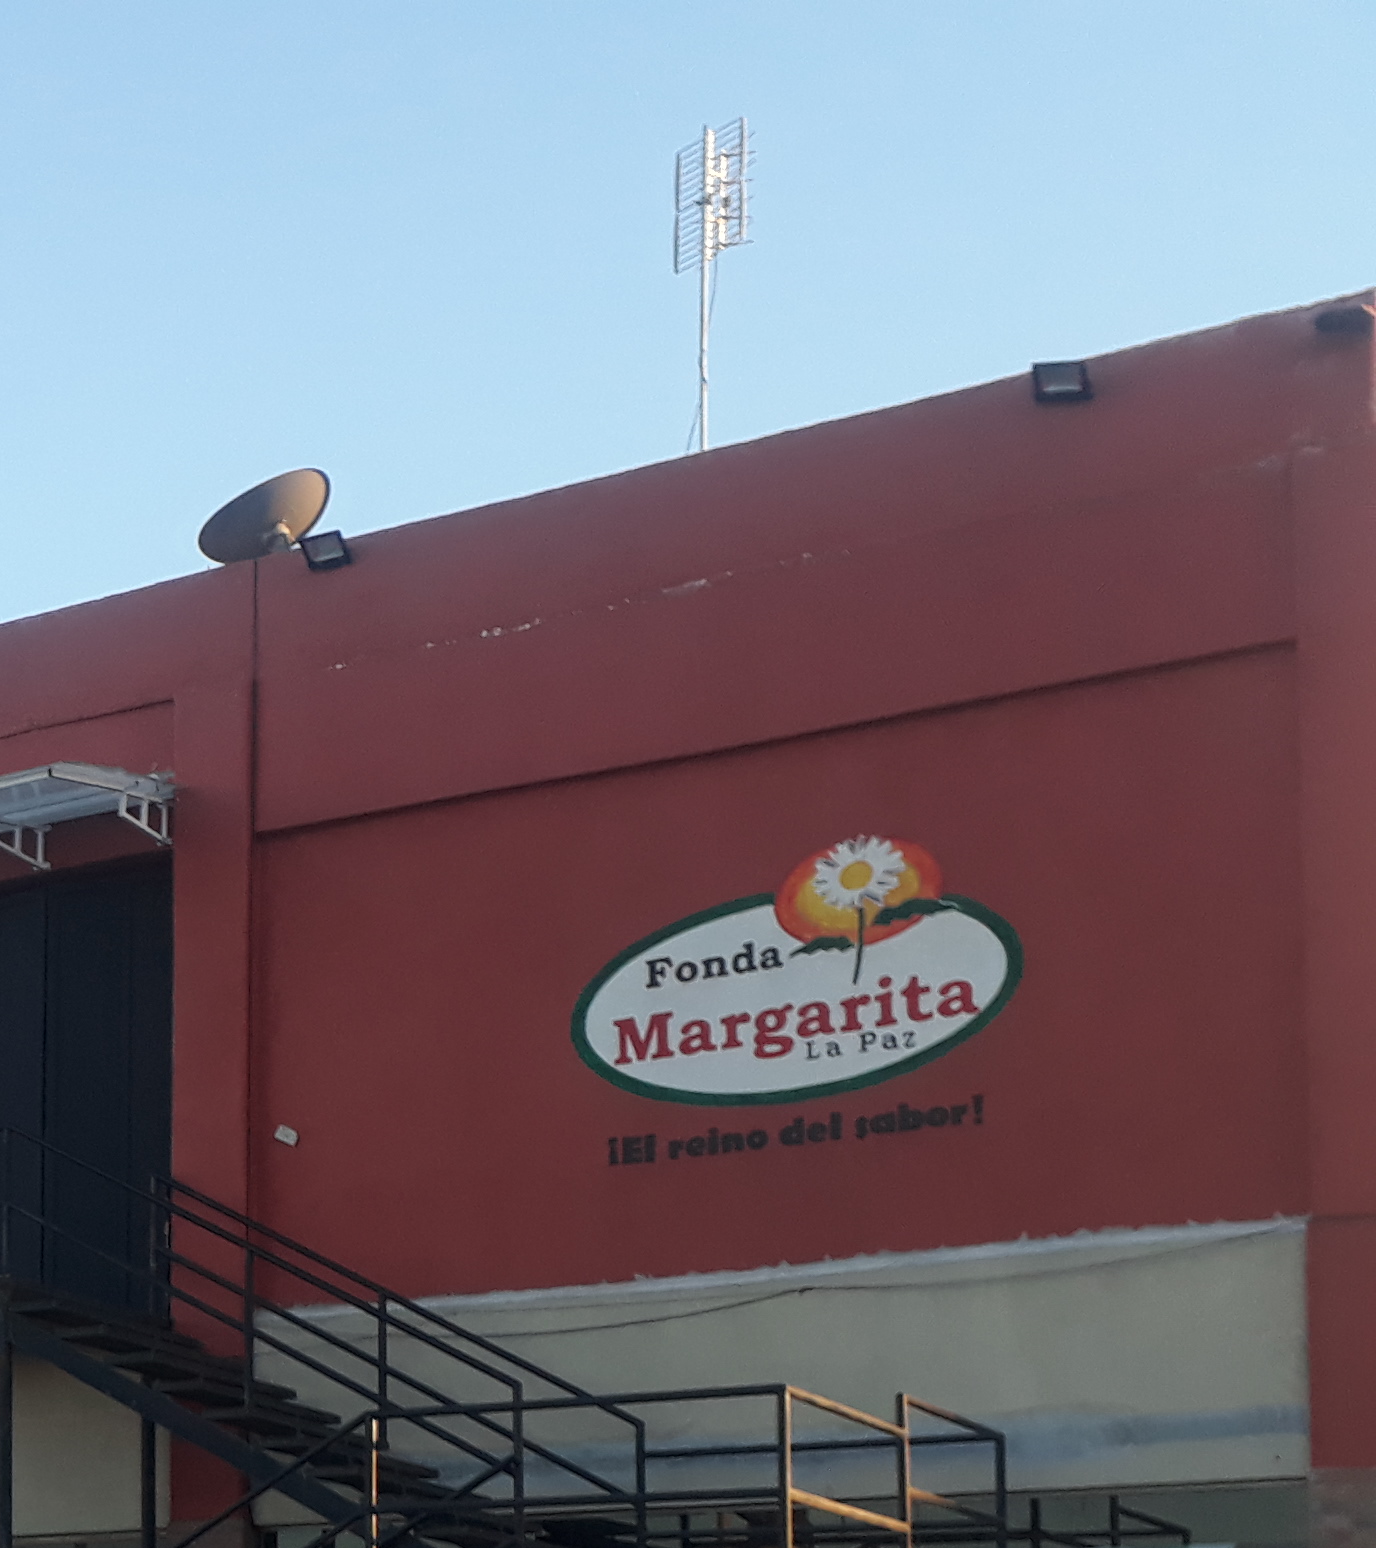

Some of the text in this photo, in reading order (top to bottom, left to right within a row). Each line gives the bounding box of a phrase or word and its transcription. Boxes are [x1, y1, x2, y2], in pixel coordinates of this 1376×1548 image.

[645, 941, 784, 989] Fonda
[613, 975, 980, 1066] Margarita
[806, 1030, 917, 1061] La Paz
[607, 1095, 984, 1167] ¡El reino del sabor!
